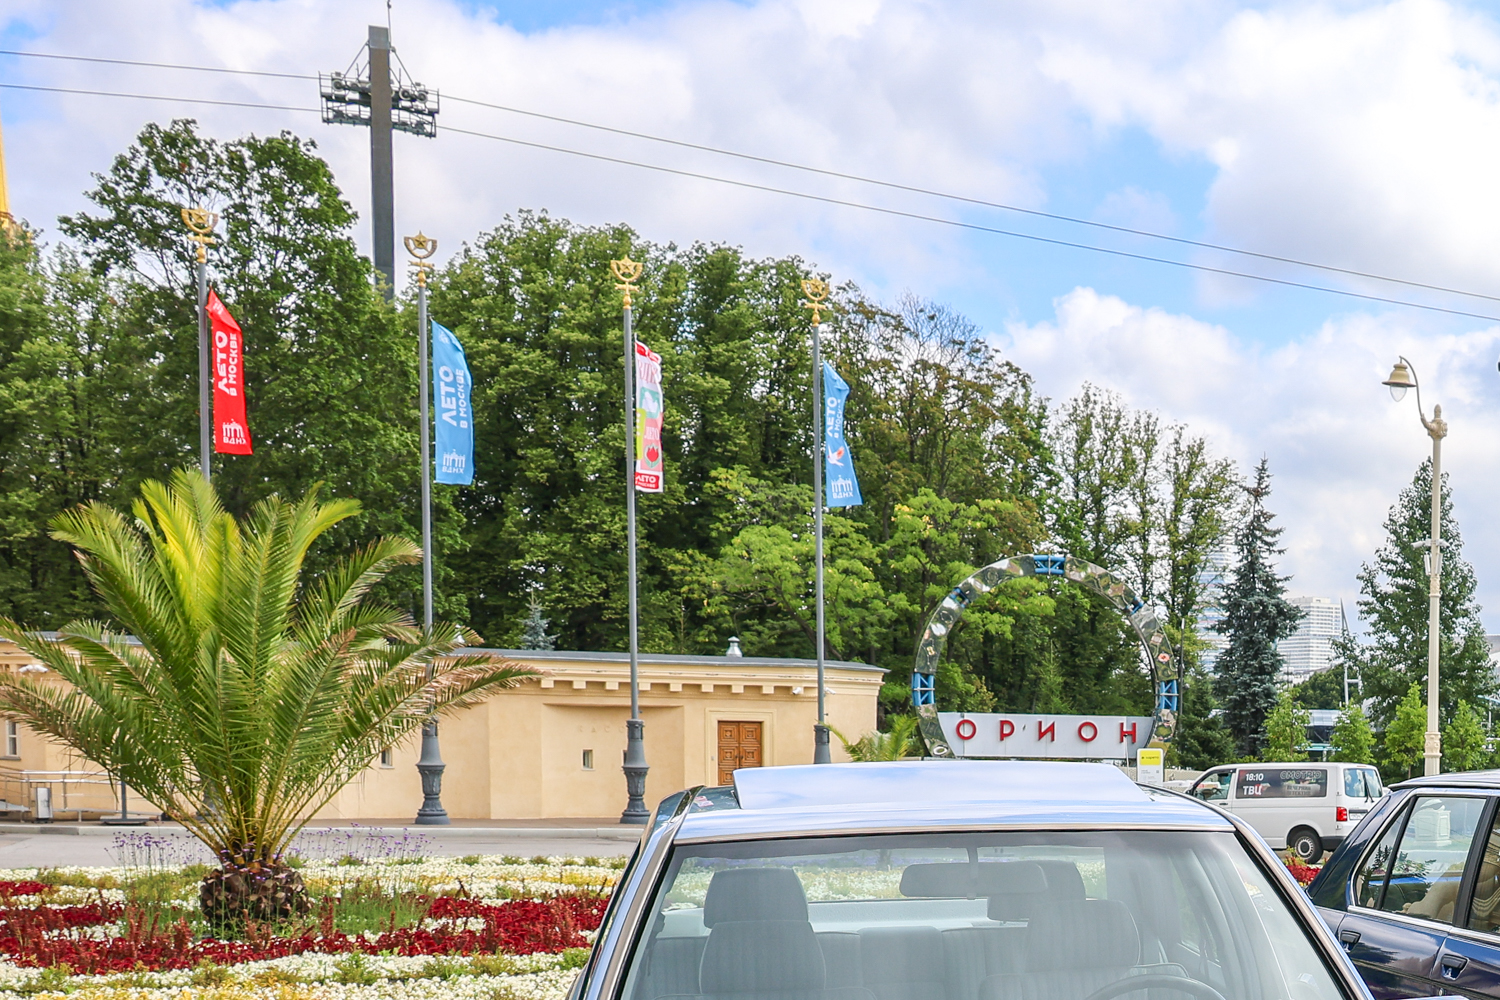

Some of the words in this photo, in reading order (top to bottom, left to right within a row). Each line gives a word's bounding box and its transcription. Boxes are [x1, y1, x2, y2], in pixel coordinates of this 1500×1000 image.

[215, 331, 230, 395] ЛЕТО
[228, 333, 238, 384] МОСКВЕ
[439, 365, 457, 427] ЛЕТО
[456, 369, 468, 418] МОСКВЕ
[827, 396, 837, 437] ЛЕТО
[442, 466, 465, 474] ВДНХ
[832, 491, 853, 499] ВДНХ
[956, 719, 1137, 743] ОРИОН
[1243, 786, 1262, 795] ТВЦ
[1245, 773, 1264, 781] 18:10
